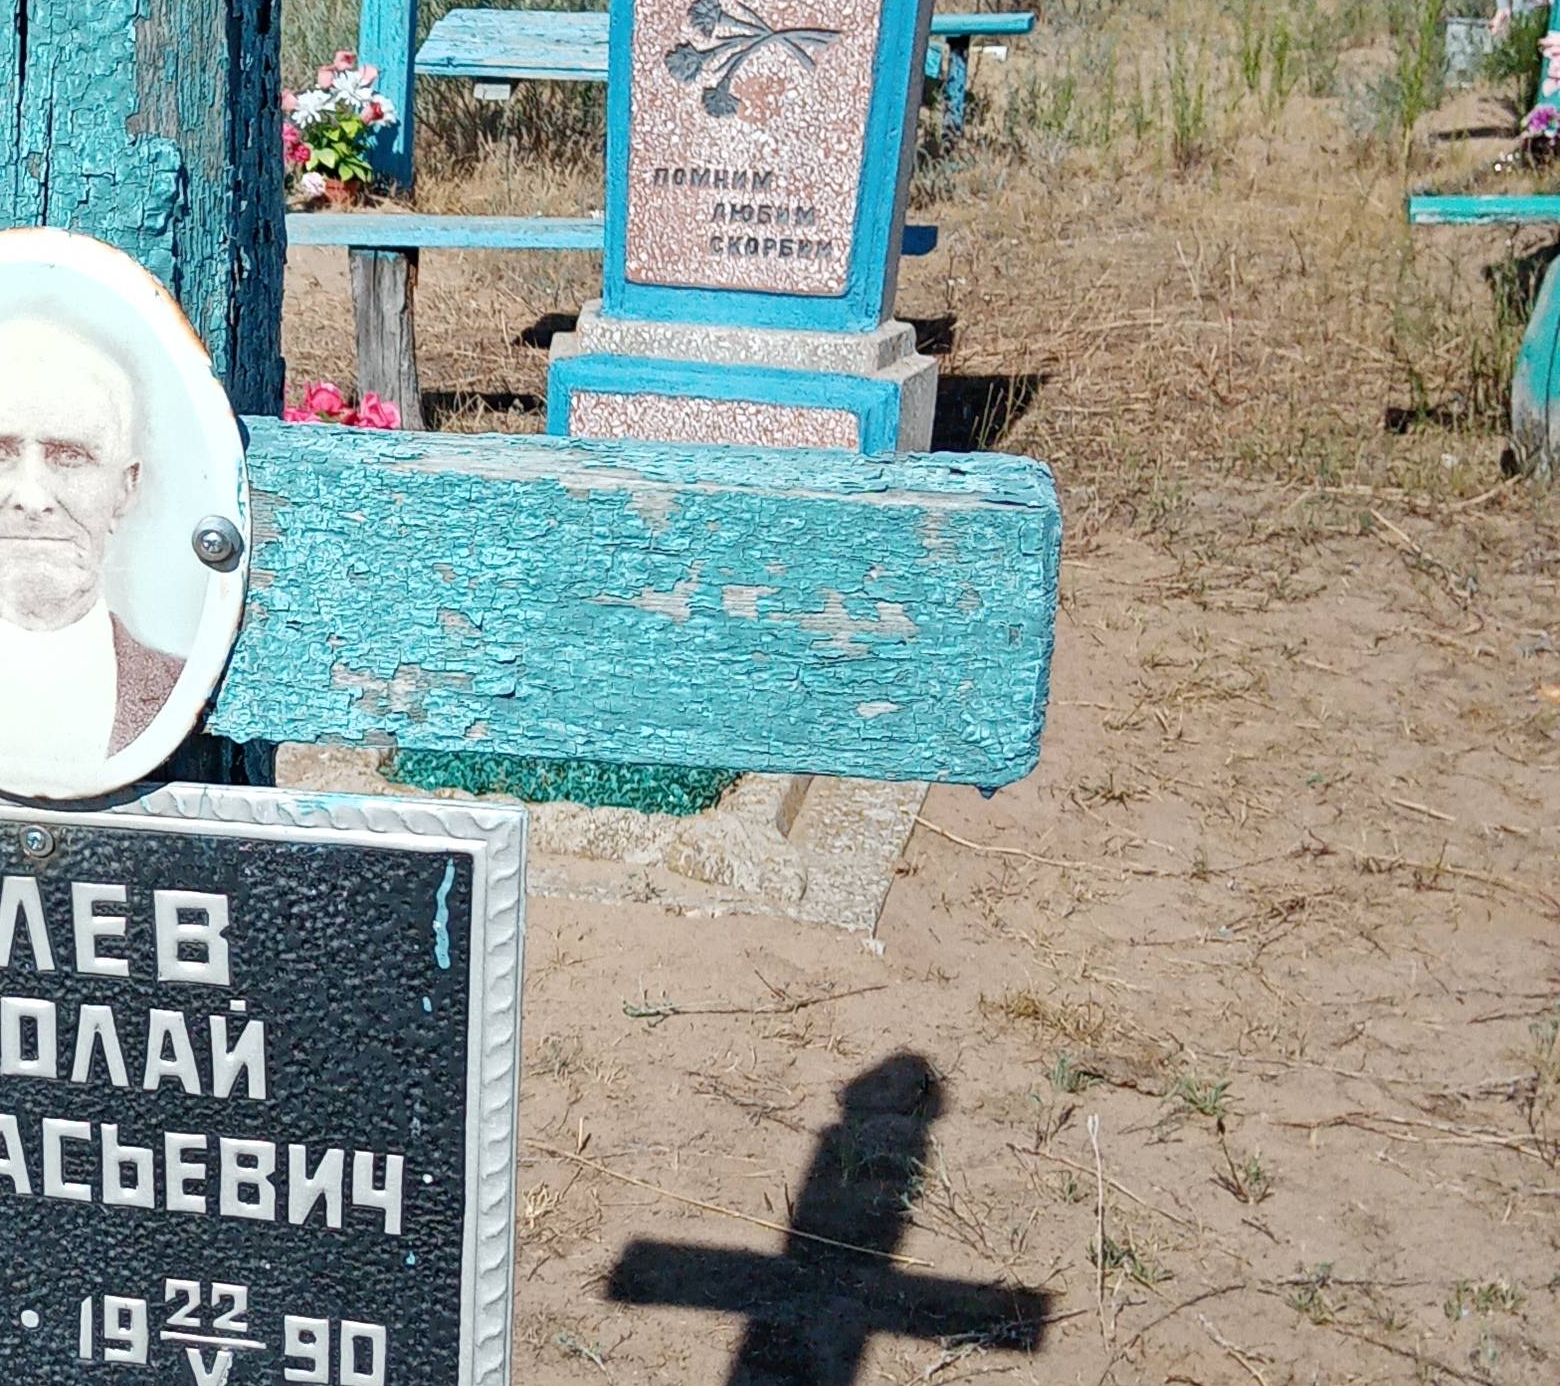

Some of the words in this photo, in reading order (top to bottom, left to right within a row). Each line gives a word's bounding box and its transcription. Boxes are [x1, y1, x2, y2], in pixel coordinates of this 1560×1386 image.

[654, 167, 773, 190] ПОМНИМ
[711, 202, 816, 225] ЛЮБИМ
[710, 235, 833, 259] СКОРБИМ
[79, 1292, 150, 1365] 19
[163, 1277, 250, 1334] 22
